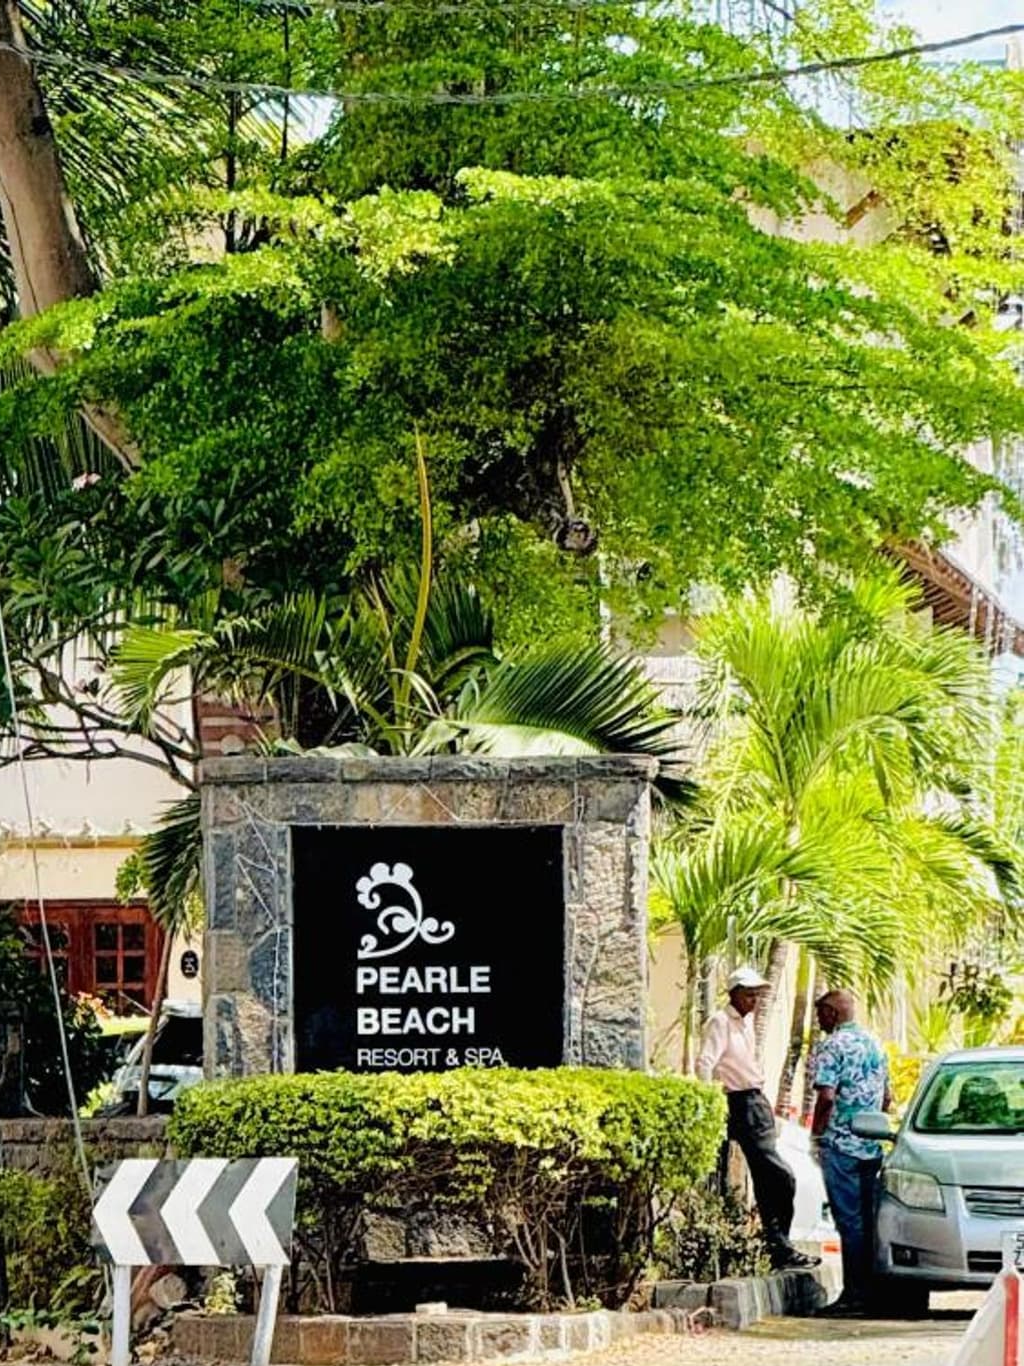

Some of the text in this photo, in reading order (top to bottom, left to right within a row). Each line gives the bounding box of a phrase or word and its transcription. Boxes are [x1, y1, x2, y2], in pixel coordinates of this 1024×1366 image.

[356, 966, 491, 994] PEARLE
[357, 1006, 475, 1035] BEACH
[357, 1047, 505, 1067] RESORT & SPA
